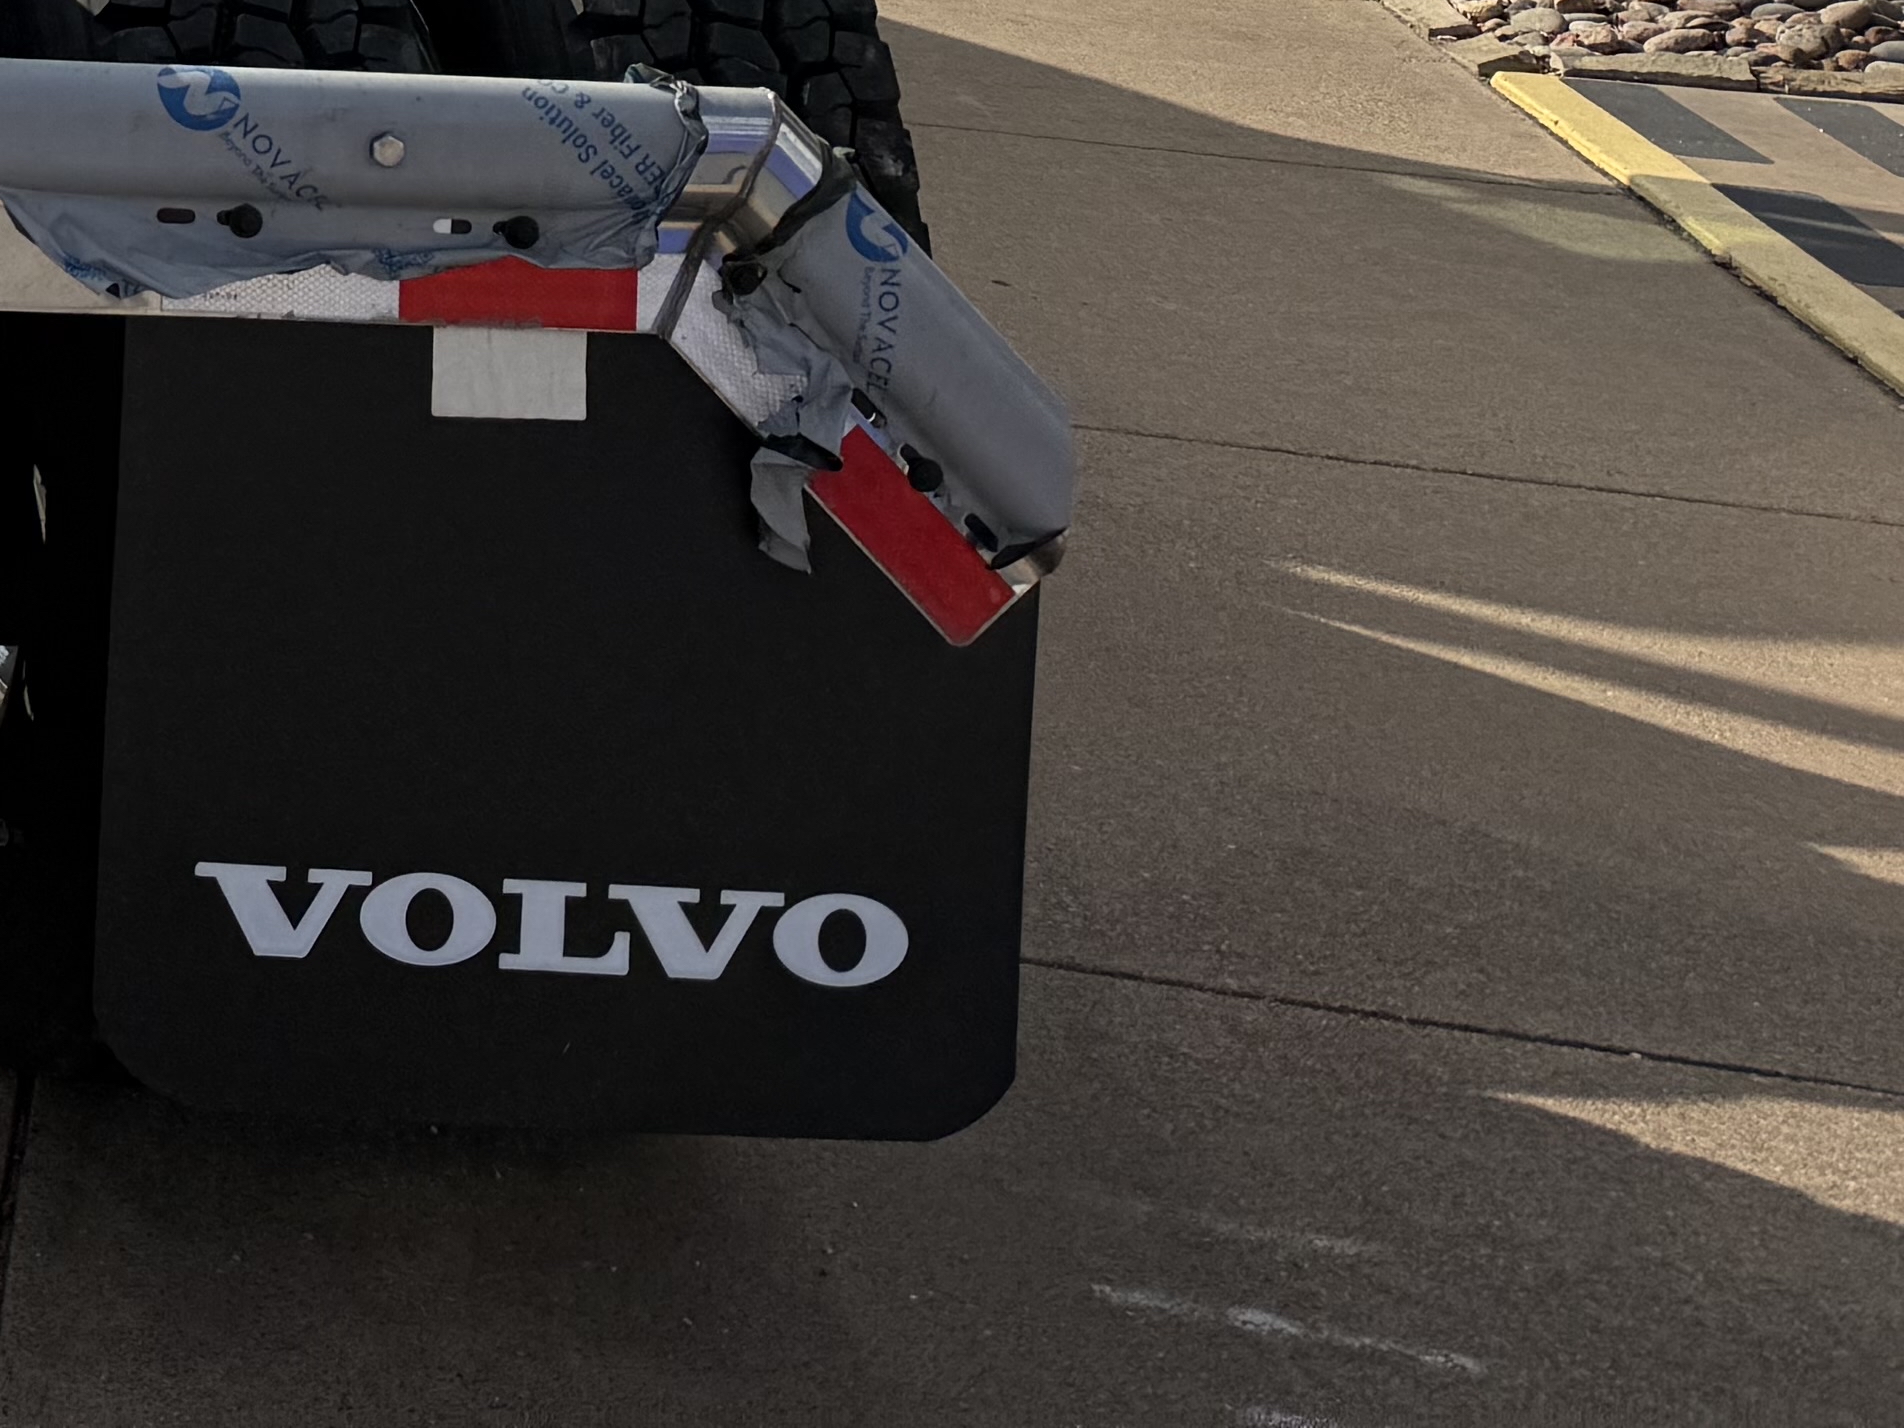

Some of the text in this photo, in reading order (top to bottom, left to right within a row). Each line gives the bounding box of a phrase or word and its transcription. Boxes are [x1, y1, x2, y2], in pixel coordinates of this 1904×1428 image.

[521, 87, 598, 164] Solution
[592, 107, 641, 160] Fiber
[195, 861, 910, 988] VOLVO
